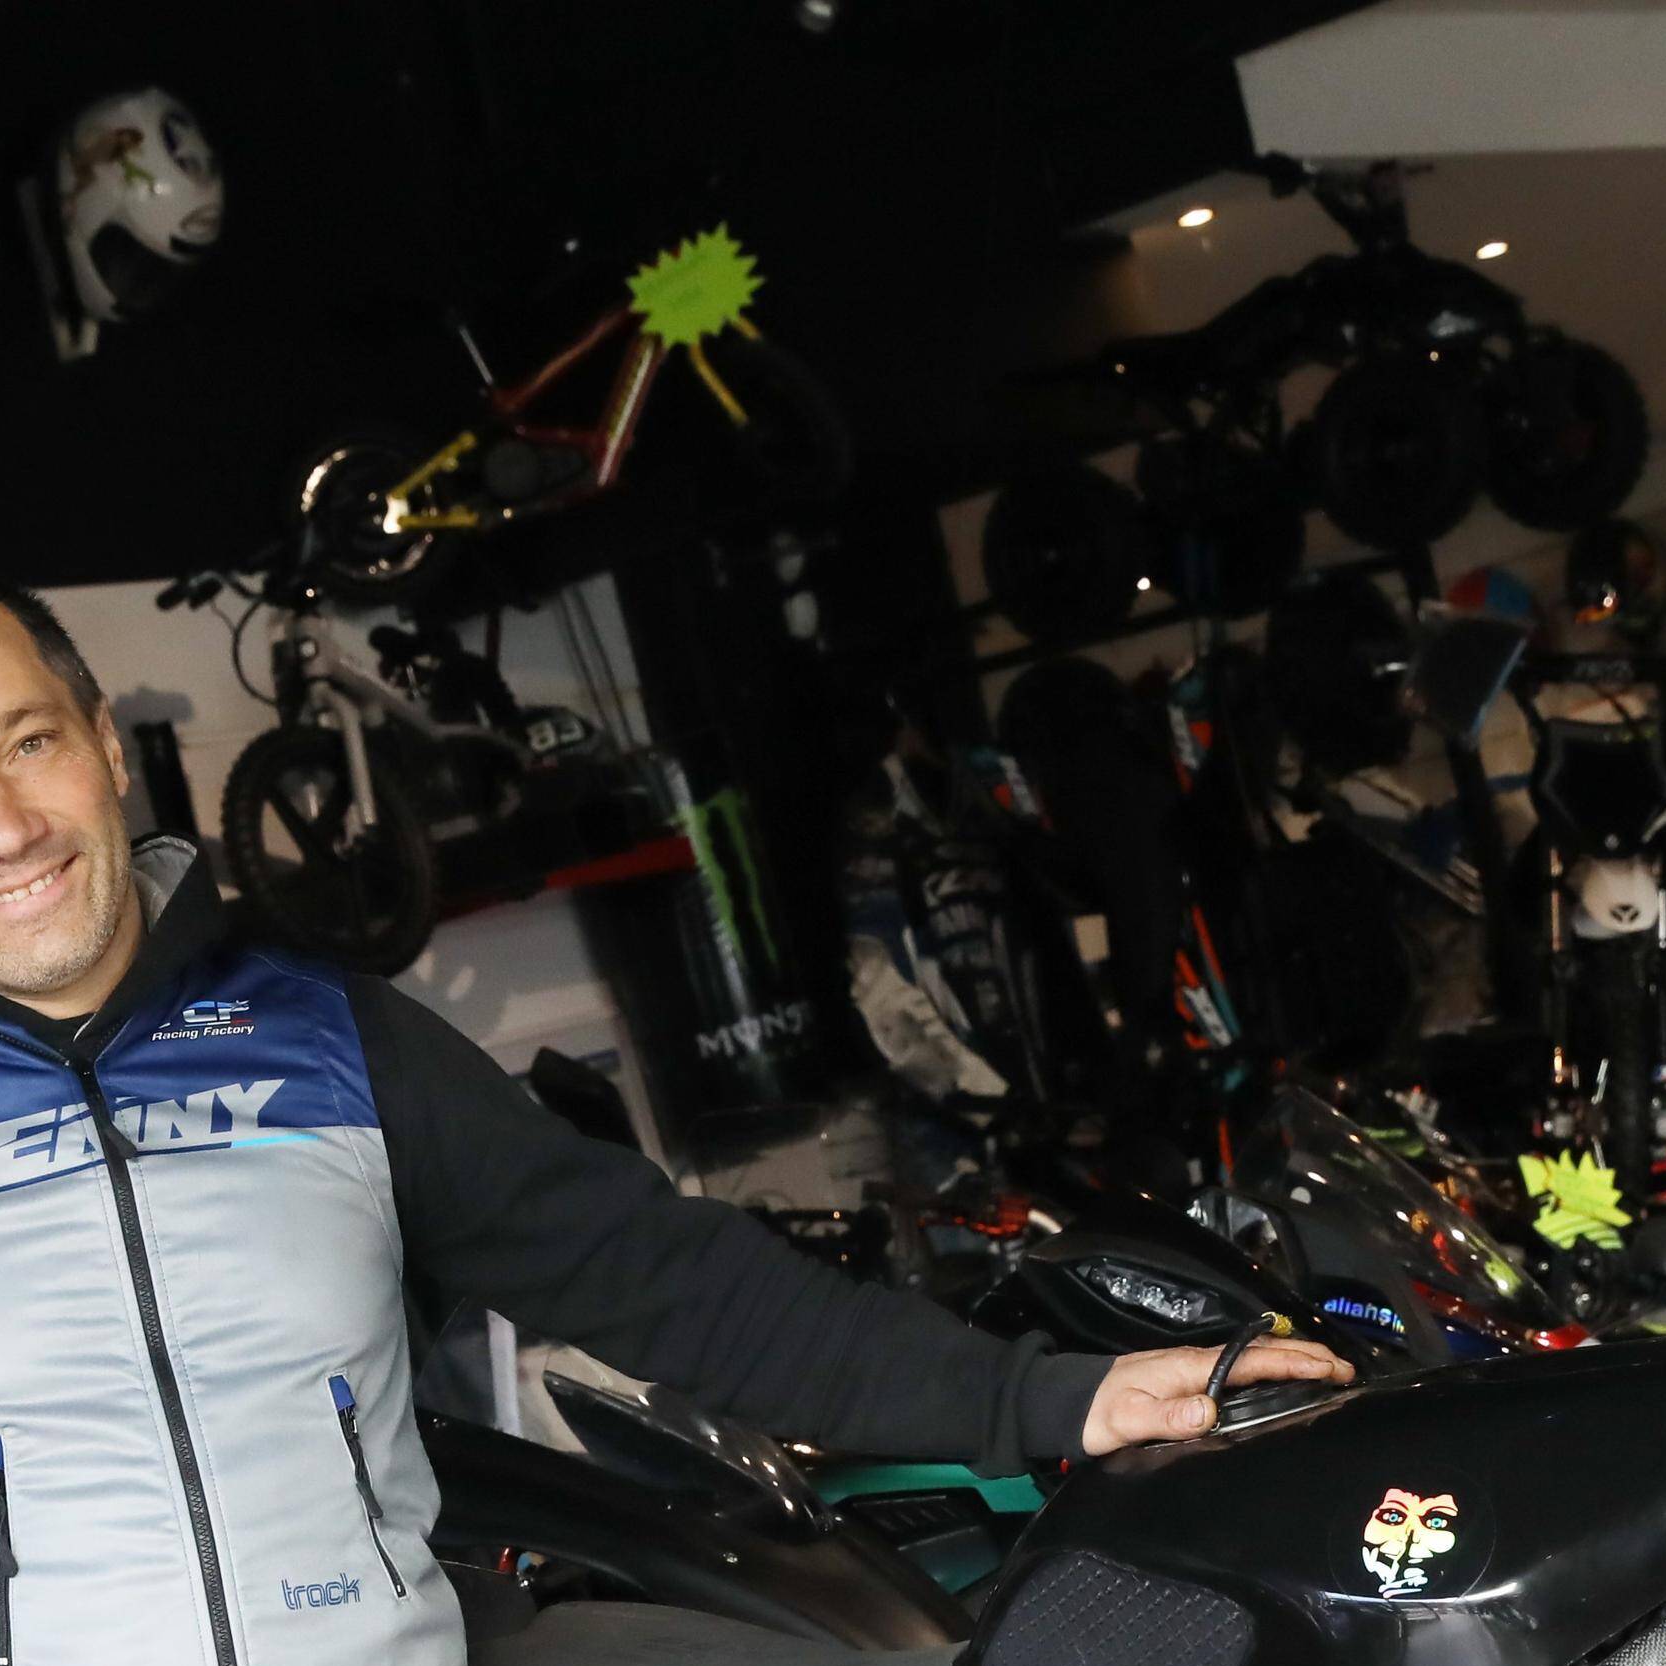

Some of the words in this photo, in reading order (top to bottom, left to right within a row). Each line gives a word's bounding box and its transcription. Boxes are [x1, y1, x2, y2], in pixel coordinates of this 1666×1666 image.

[152, 1028, 199, 1042] Racing
[202, 1025, 255, 1037] Factory
[280, 1572, 361, 1611] track
